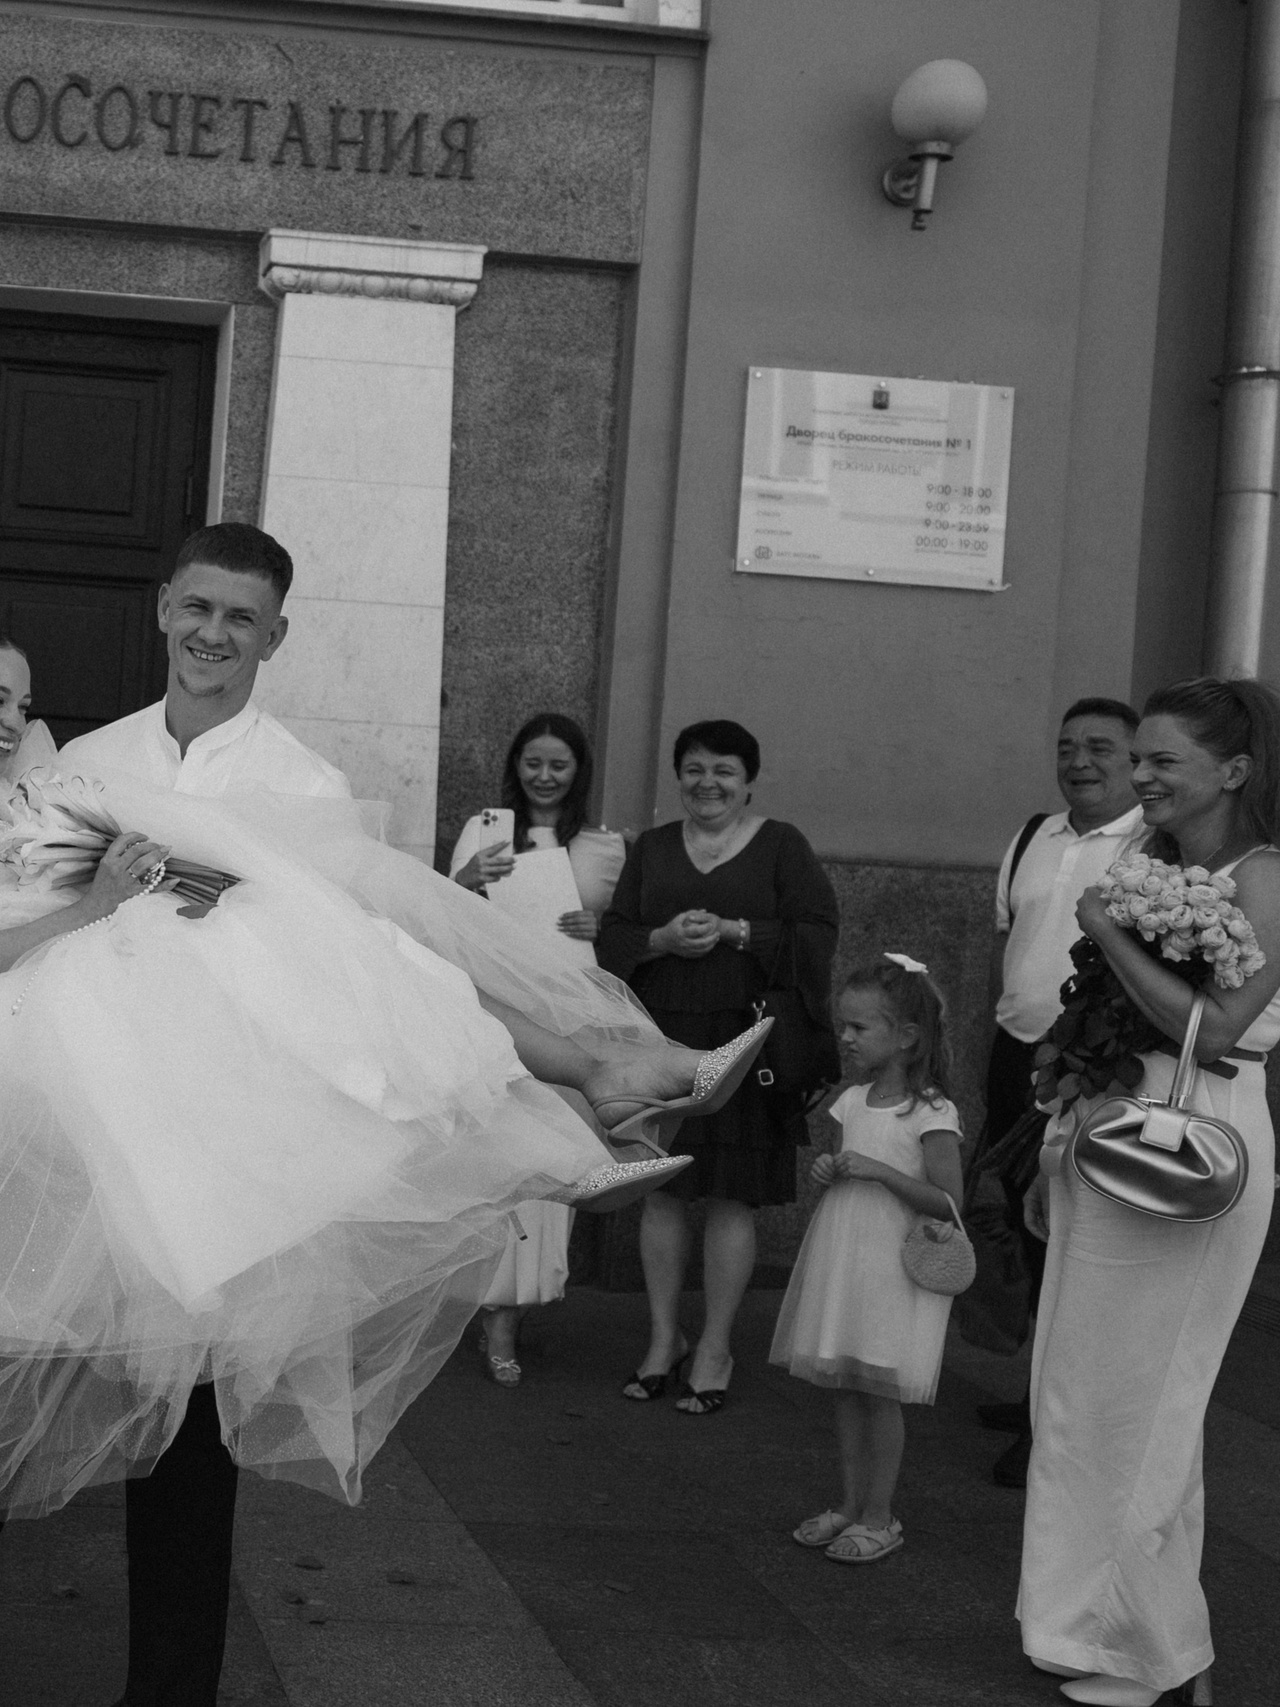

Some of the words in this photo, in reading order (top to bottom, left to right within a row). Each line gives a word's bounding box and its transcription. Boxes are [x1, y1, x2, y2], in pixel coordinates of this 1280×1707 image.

[786, 425, 836, 442] Дворец
[838, 429, 943, 448] бракосочетания
[832, 459, 874, 473] РЕЖИМ
[877, 462, 922, 477] РАБОТЫ
[927, 483, 952, 496] 9:00
[962, 486, 992, 499] 1800
[926, 501, 951, 513] 9:00
[915, 535, 949, 549] 00:00
